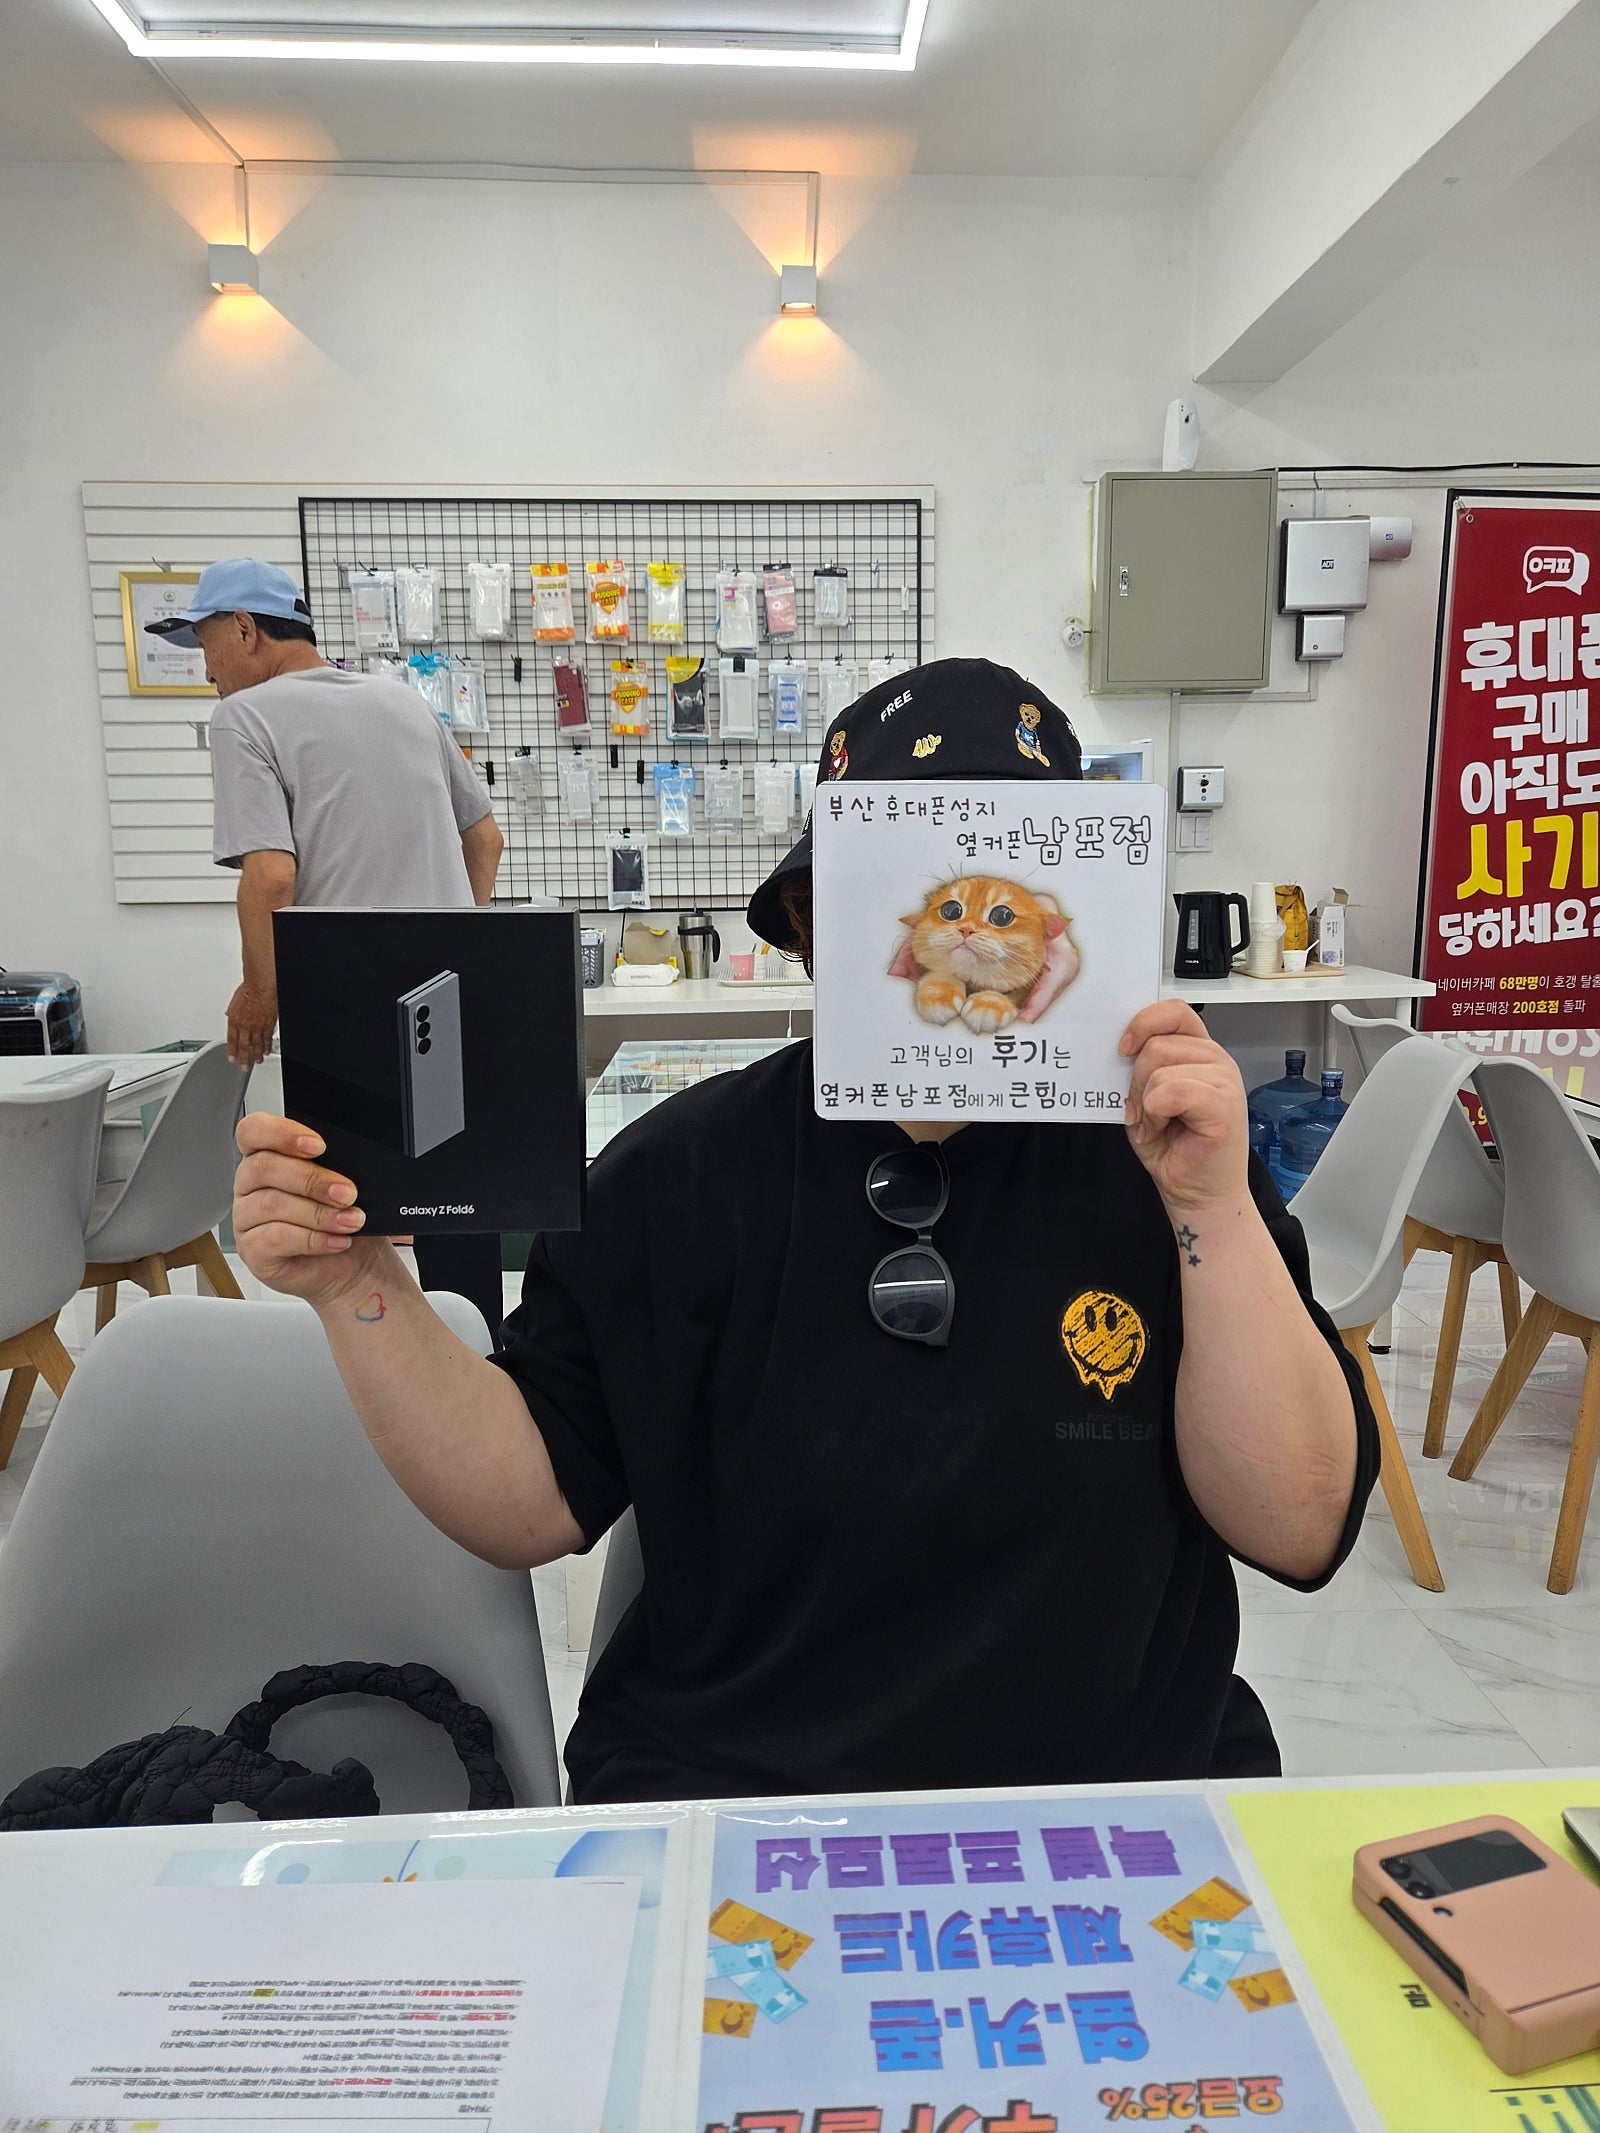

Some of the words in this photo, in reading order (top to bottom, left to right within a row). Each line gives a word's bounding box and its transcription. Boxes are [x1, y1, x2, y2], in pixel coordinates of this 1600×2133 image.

[615, 690, 641, 700] PUDDING
[880, 690, 913, 722] FREE
[1493, 688, 1589, 752] 구매
[1460, 747, 1600, 815] 아직도
[829, 795, 875, 822] 부산
[886, 794, 996, 826] 휴대폰성지
[1456, 811, 1599, 900] 사기
[1437, 976, 1496, 992] 네이버카페
[1499, 974, 1550, 991] 68만명이
[1553, 974, 1577, 989] 호갱
[1451, 1001, 1510, 1017] 옆커폰매장
[1512, 1000, 1560, 1014] 200호점
[1562, 999, 1586, 1013] 돌파
[890, 1044, 974, 1067] 고객님의
[992, 1034, 1072, 1069] 후기는
[399, 1206, 438, 1217] Galaxy
[438, 1205, 445, 1215] Z
[446, 1204, 475, 1215] Fold6
[1055, 1422, 1113, 1440] SMILE
[1119, 1423, 1160, 1440] BEA
[756, 1830, 1026, 1893] 프로모션
[1040, 1825, 1182, 1882] 특별
[833, 1904, 1134, 1974] 제휴카드
[868, 1990, 1150, 2072] 옆.커.폰
[1098, 2076, 1283, 2120] 요금25%
